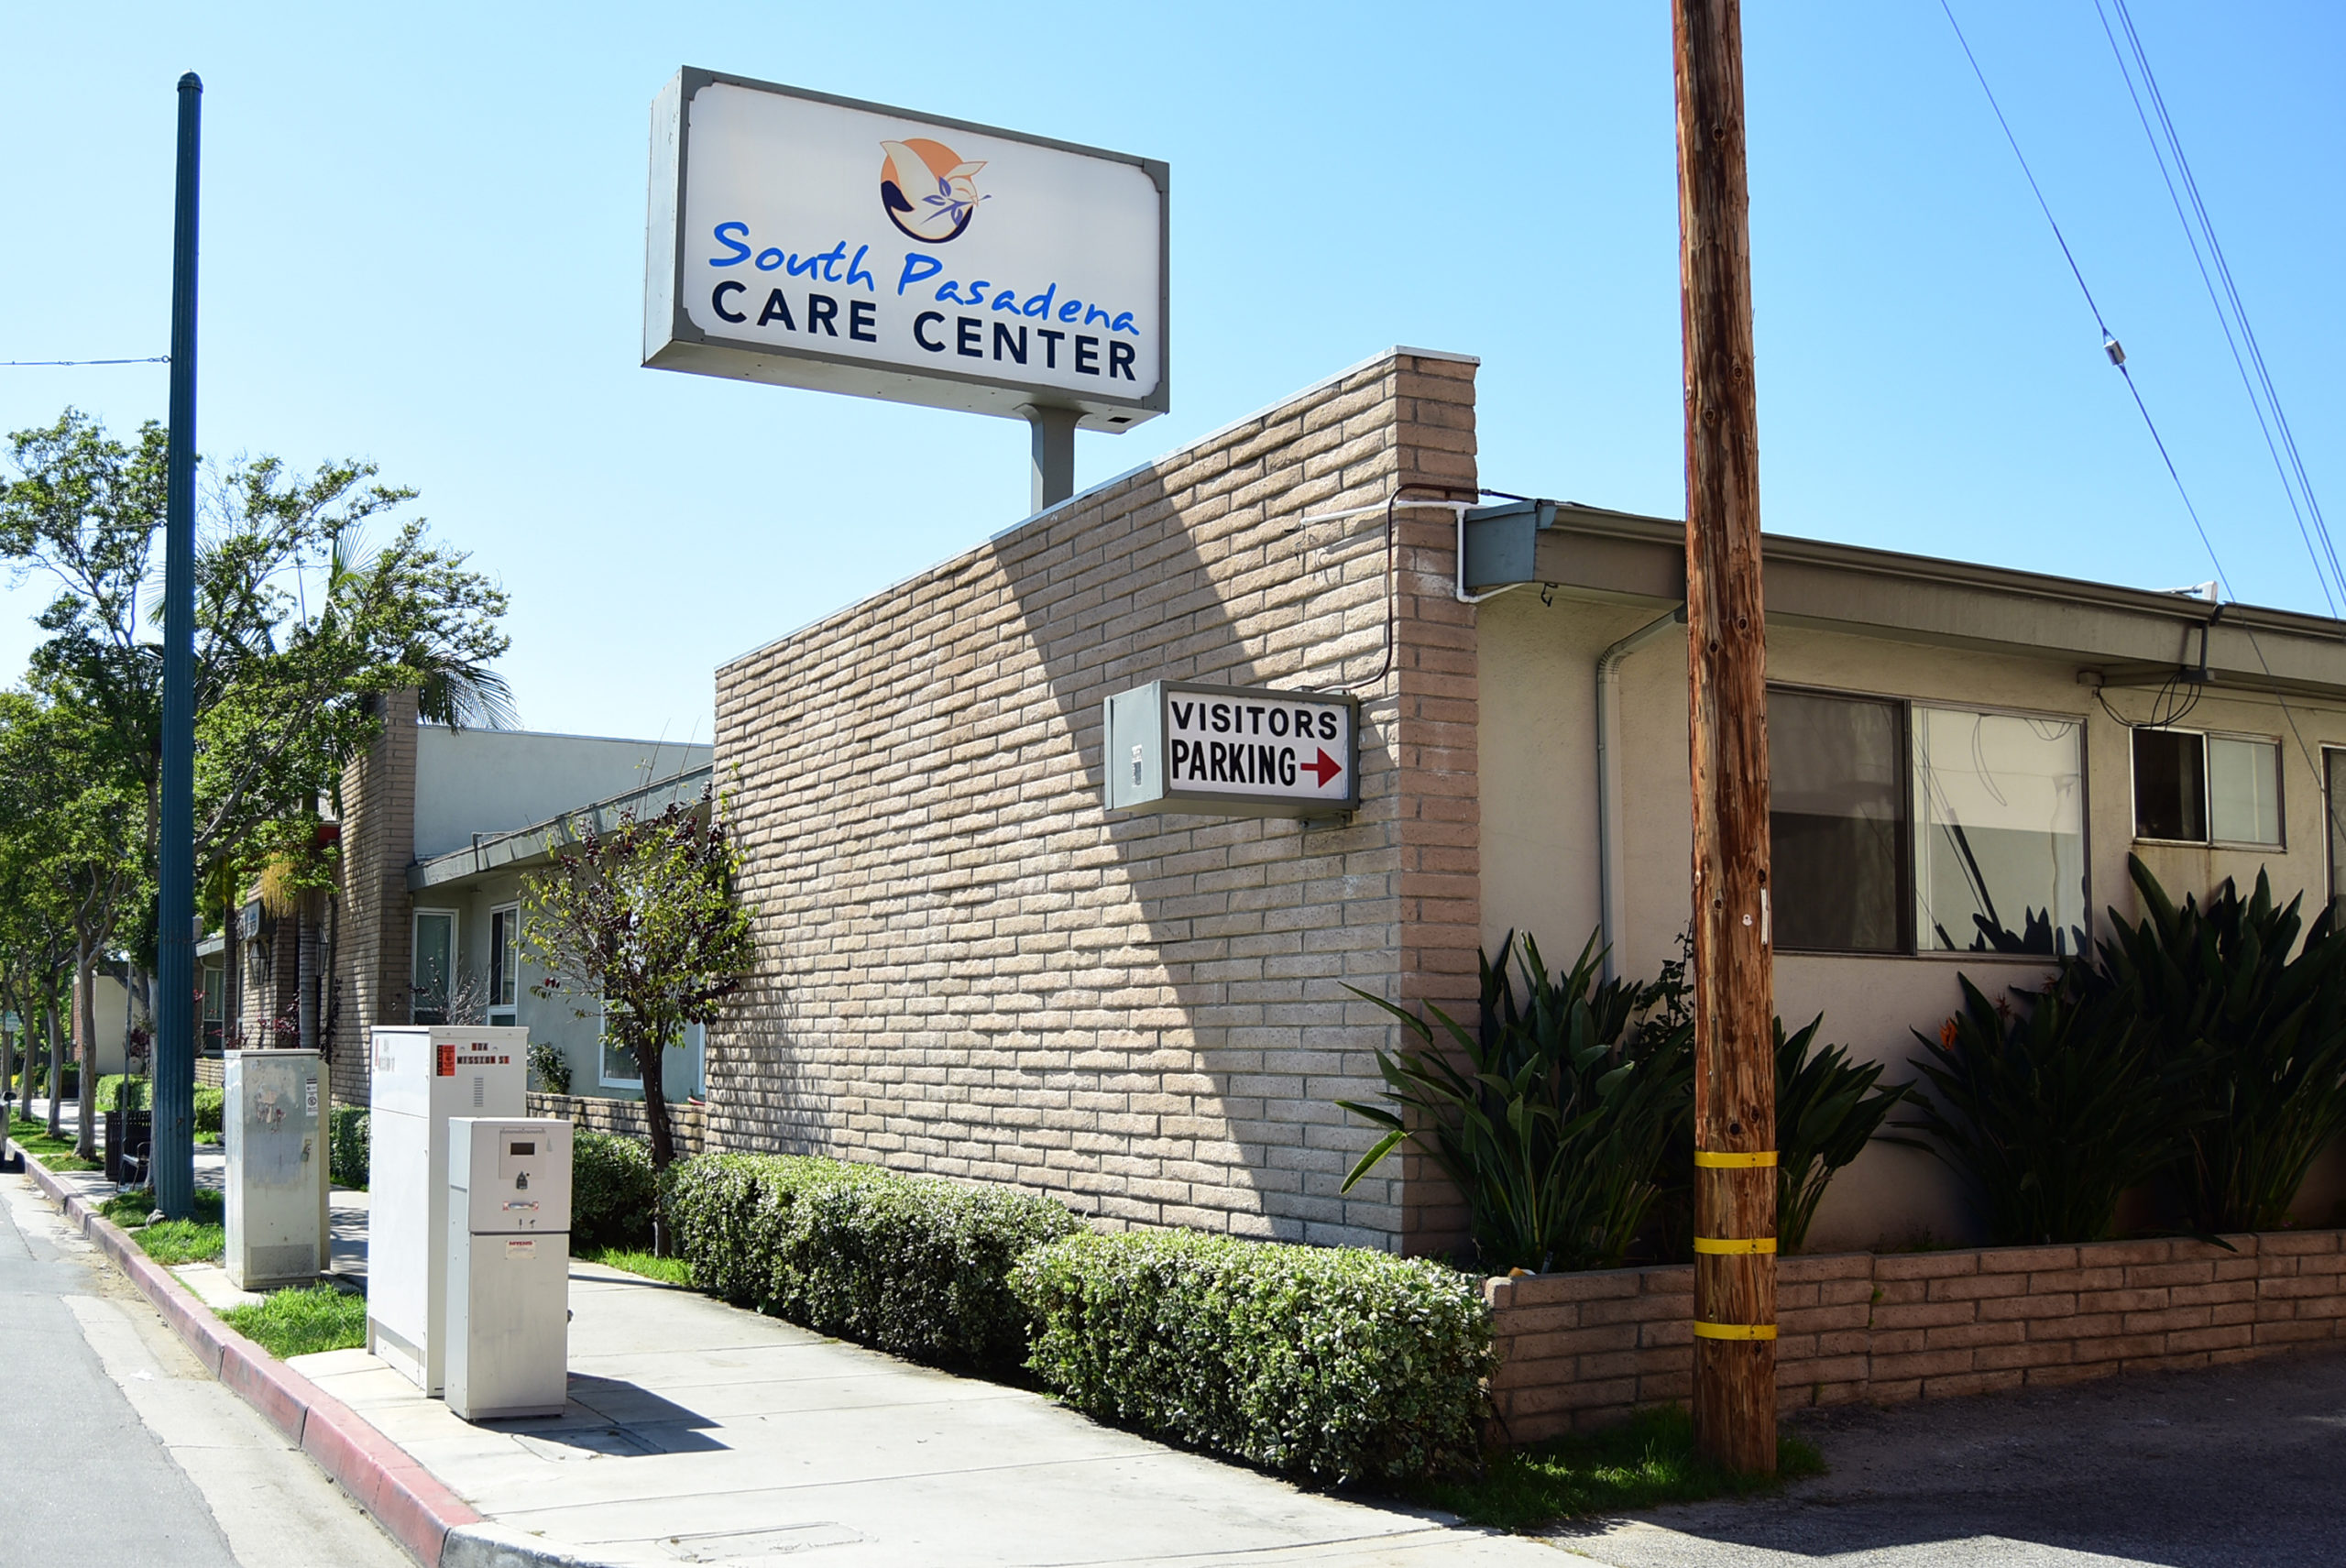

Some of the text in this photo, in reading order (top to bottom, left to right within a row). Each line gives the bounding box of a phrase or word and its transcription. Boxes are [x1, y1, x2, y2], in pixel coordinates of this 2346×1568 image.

[708, 221, 1141, 336] South Pasadena
[711, 280, 1137, 381] CARE CENTER
[1170, 700, 1337, 740] VISITORS
[1171, 739, 1297, 787] PARKING
[457, 1056, 496, 1064] MISSION
